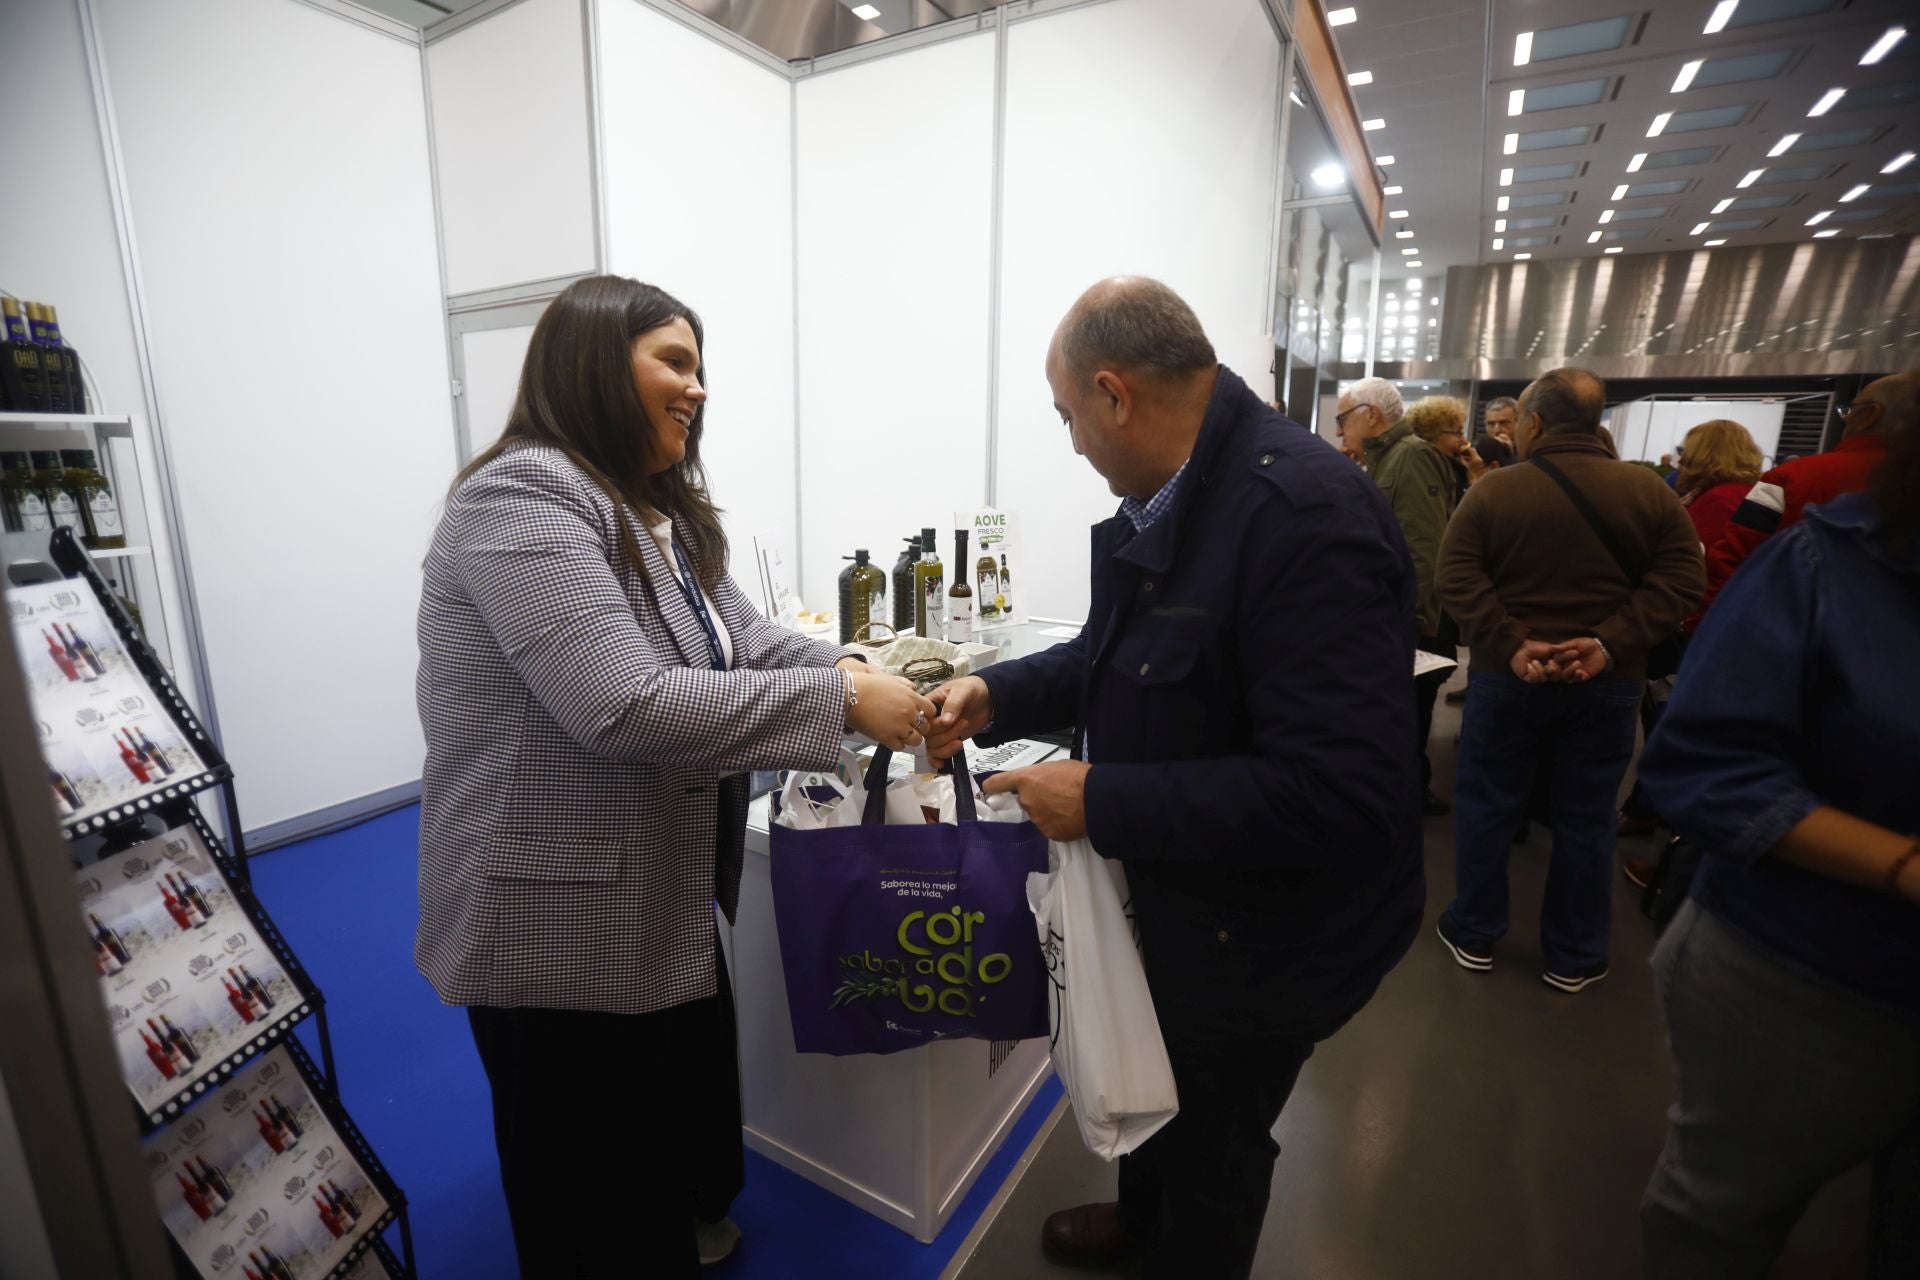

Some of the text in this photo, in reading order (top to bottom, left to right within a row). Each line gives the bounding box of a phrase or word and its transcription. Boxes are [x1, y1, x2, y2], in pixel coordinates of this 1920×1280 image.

[975, 514, 1006, 526] AOVE
[880, 880, 921, 889] Saborea
[922, 881, 931, 889] lo
[897, 888, 943, 900] de la vida,
